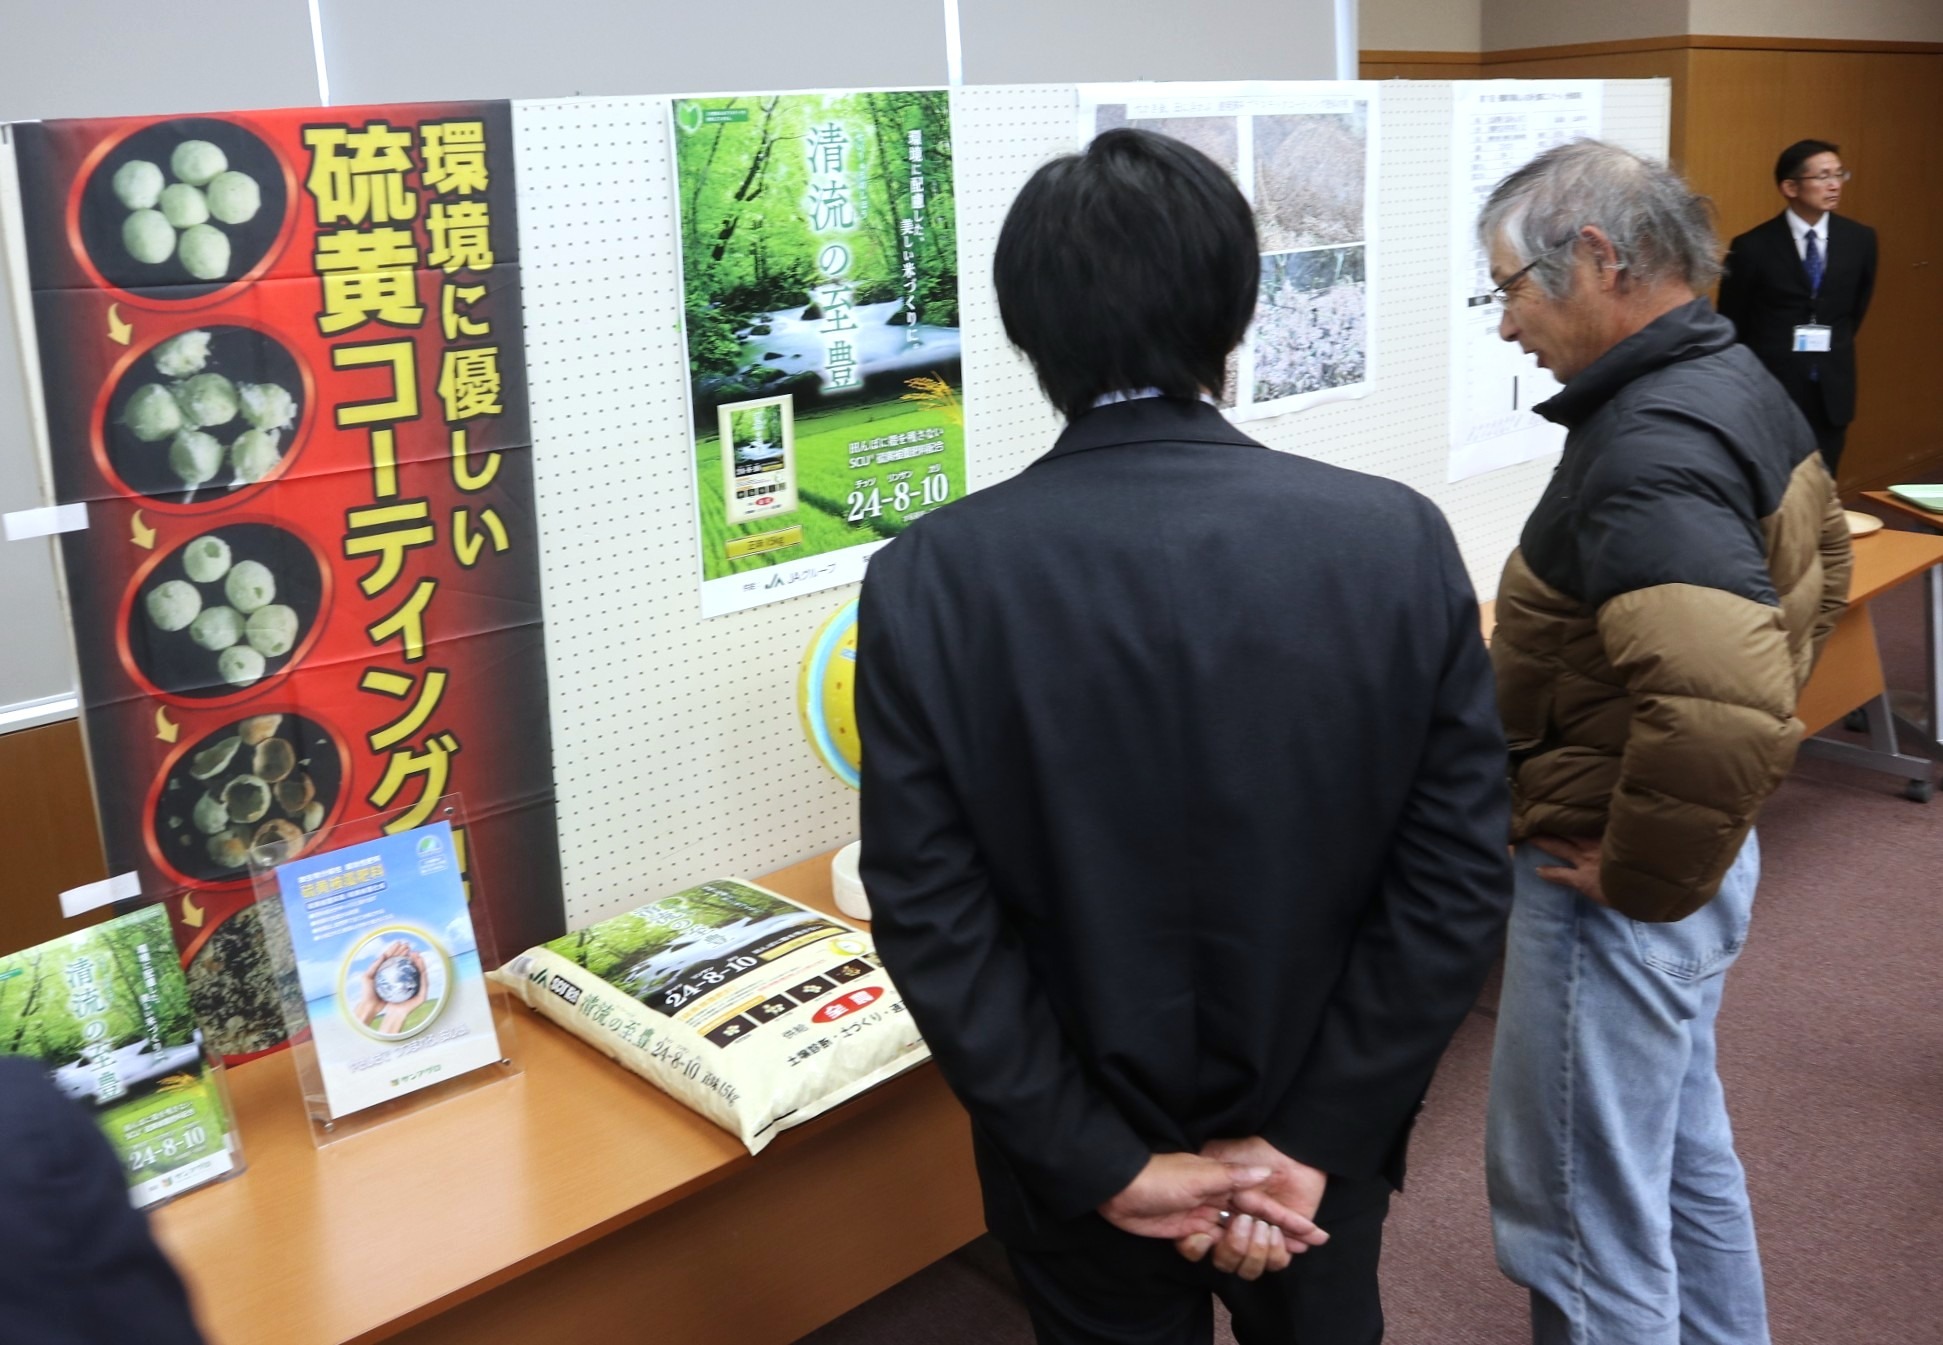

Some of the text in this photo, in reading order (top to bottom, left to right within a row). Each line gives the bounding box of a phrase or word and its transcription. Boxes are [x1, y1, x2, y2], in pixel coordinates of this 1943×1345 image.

[807, 122, 861, 390] 清流の至豊
[420, 121, 509, 568] 環境に優しい
[305, 123, 472, 906] 硫黄コーティング
[847, 473, 949, 522] 24-8-10
[665, 956, 758, 1008] 24-8-10
[651, 1040, 701, 1081] 24-8-10
[129, 1126, 206, 1171] 24-8-10
